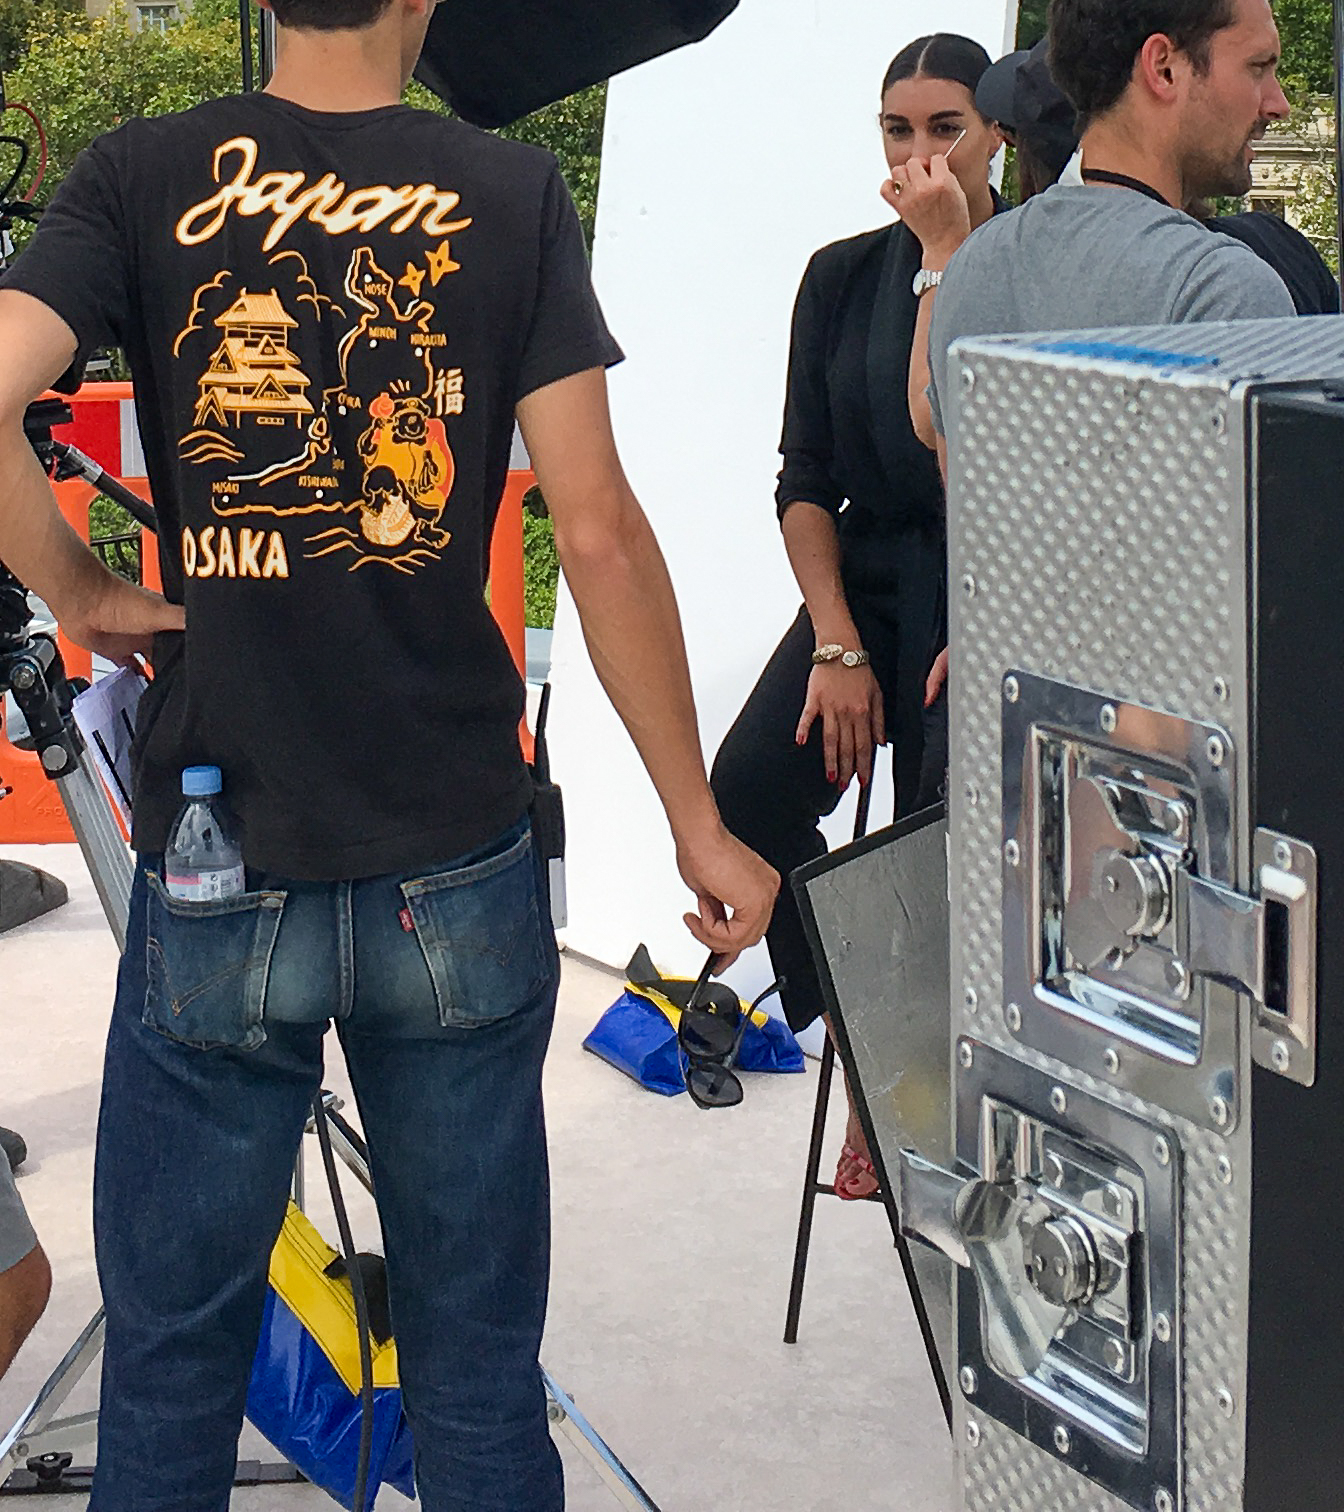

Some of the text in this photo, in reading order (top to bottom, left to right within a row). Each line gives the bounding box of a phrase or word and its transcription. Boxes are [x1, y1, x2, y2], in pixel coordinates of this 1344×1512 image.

[176, 135, 473, 253] Japan
[364, 283, 388, 295] NOSE
[434, 368, 464, 416] 福
[181, 526, 290, 579] OSAKA
